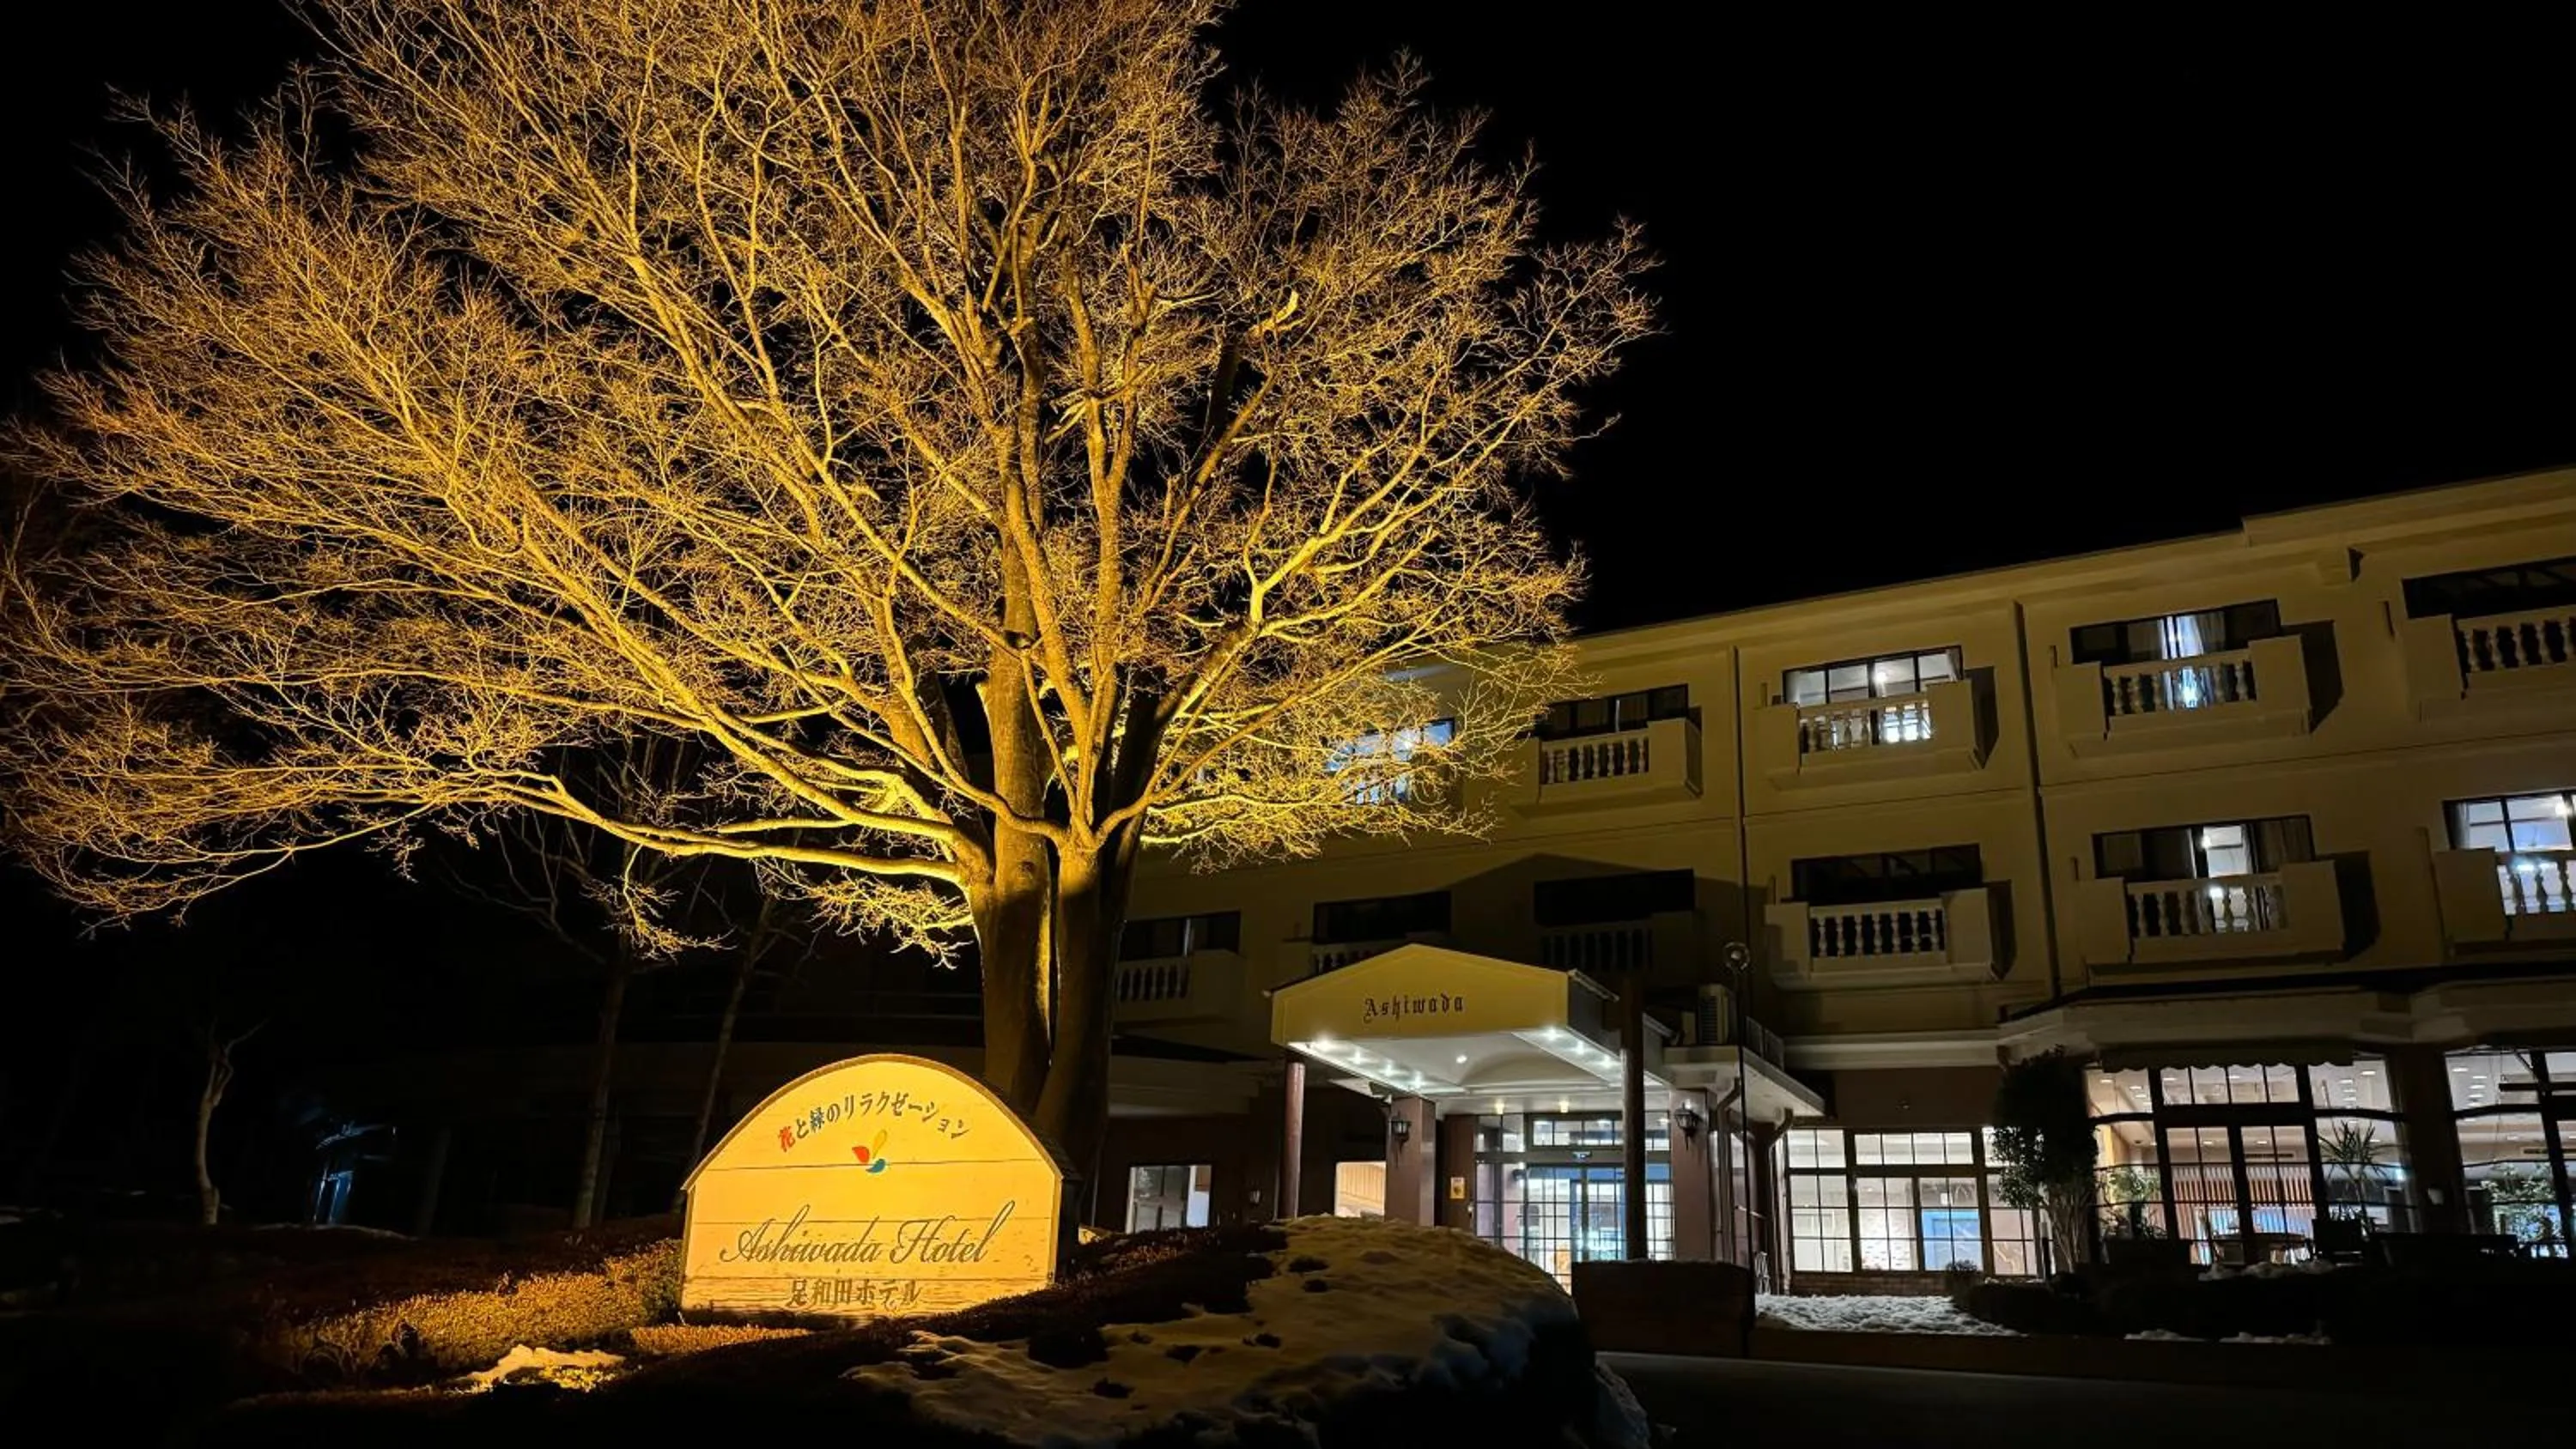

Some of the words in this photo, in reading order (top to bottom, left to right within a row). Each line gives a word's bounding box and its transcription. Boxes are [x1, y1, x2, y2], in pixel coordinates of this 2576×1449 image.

[1363, 992, 1463, 1024] Ashiwada
[778, 1091, 970, 1153] 花と緑のリラクゼーション
[720, 1203, 882, 1263] Ashiwada
[889, 1200, 1015, 1264] Hotel
[787, 1277, 921, 1307] 足和田ホテル
